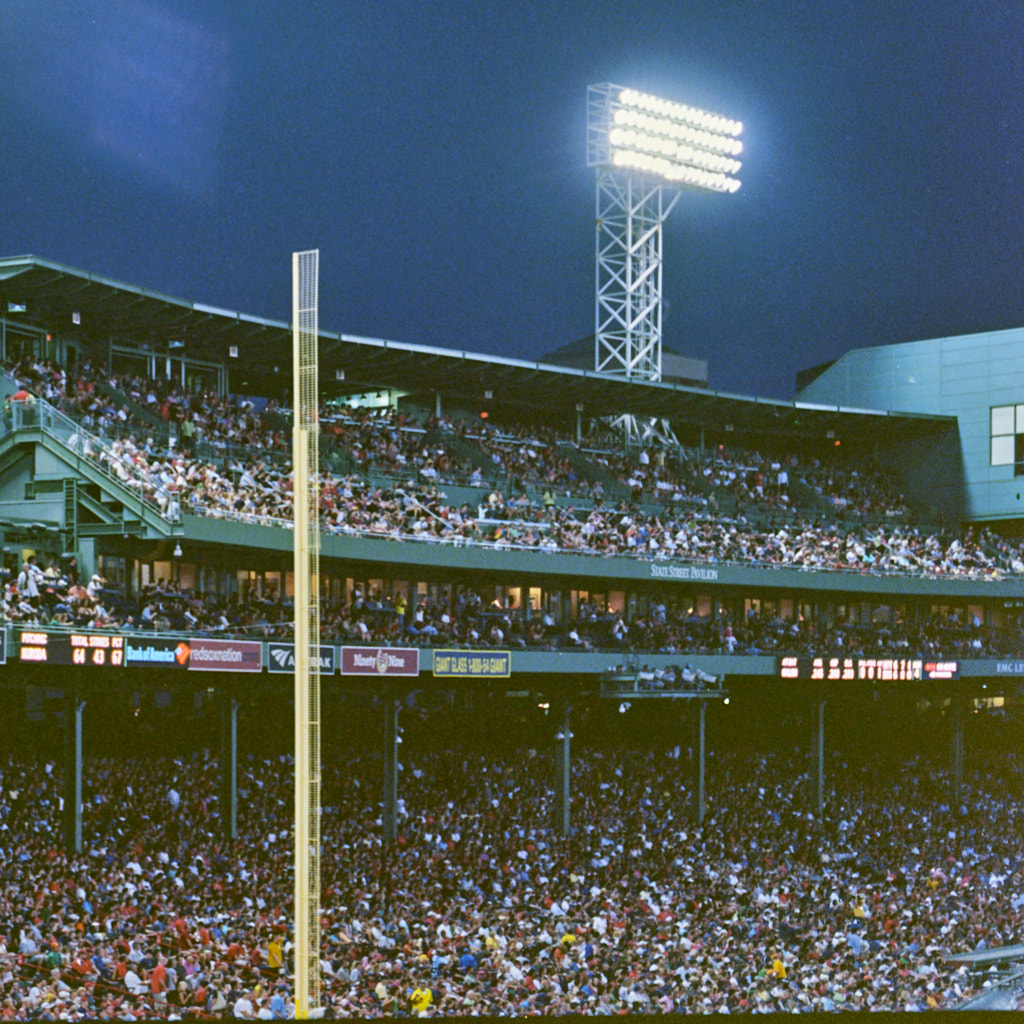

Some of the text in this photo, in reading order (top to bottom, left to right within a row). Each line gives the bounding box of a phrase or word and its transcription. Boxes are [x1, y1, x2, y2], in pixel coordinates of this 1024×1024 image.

[651, 563, 718, 580] STATE STREET PAVILION
[74, 650, 85, 663] 64
[93, 650, 104, 664] 43
[112, 651, 122, 664] 67
[127, 645, 175, 663] Bank of America
[353, 653, 405, 669] Ninety Nine
[436, 657, 451, 673] GIANT
[451, 657, 467, 673] GLASS
[490, 658, 507, 674] GIANT
[996, 662, 1013, 673] EMC
